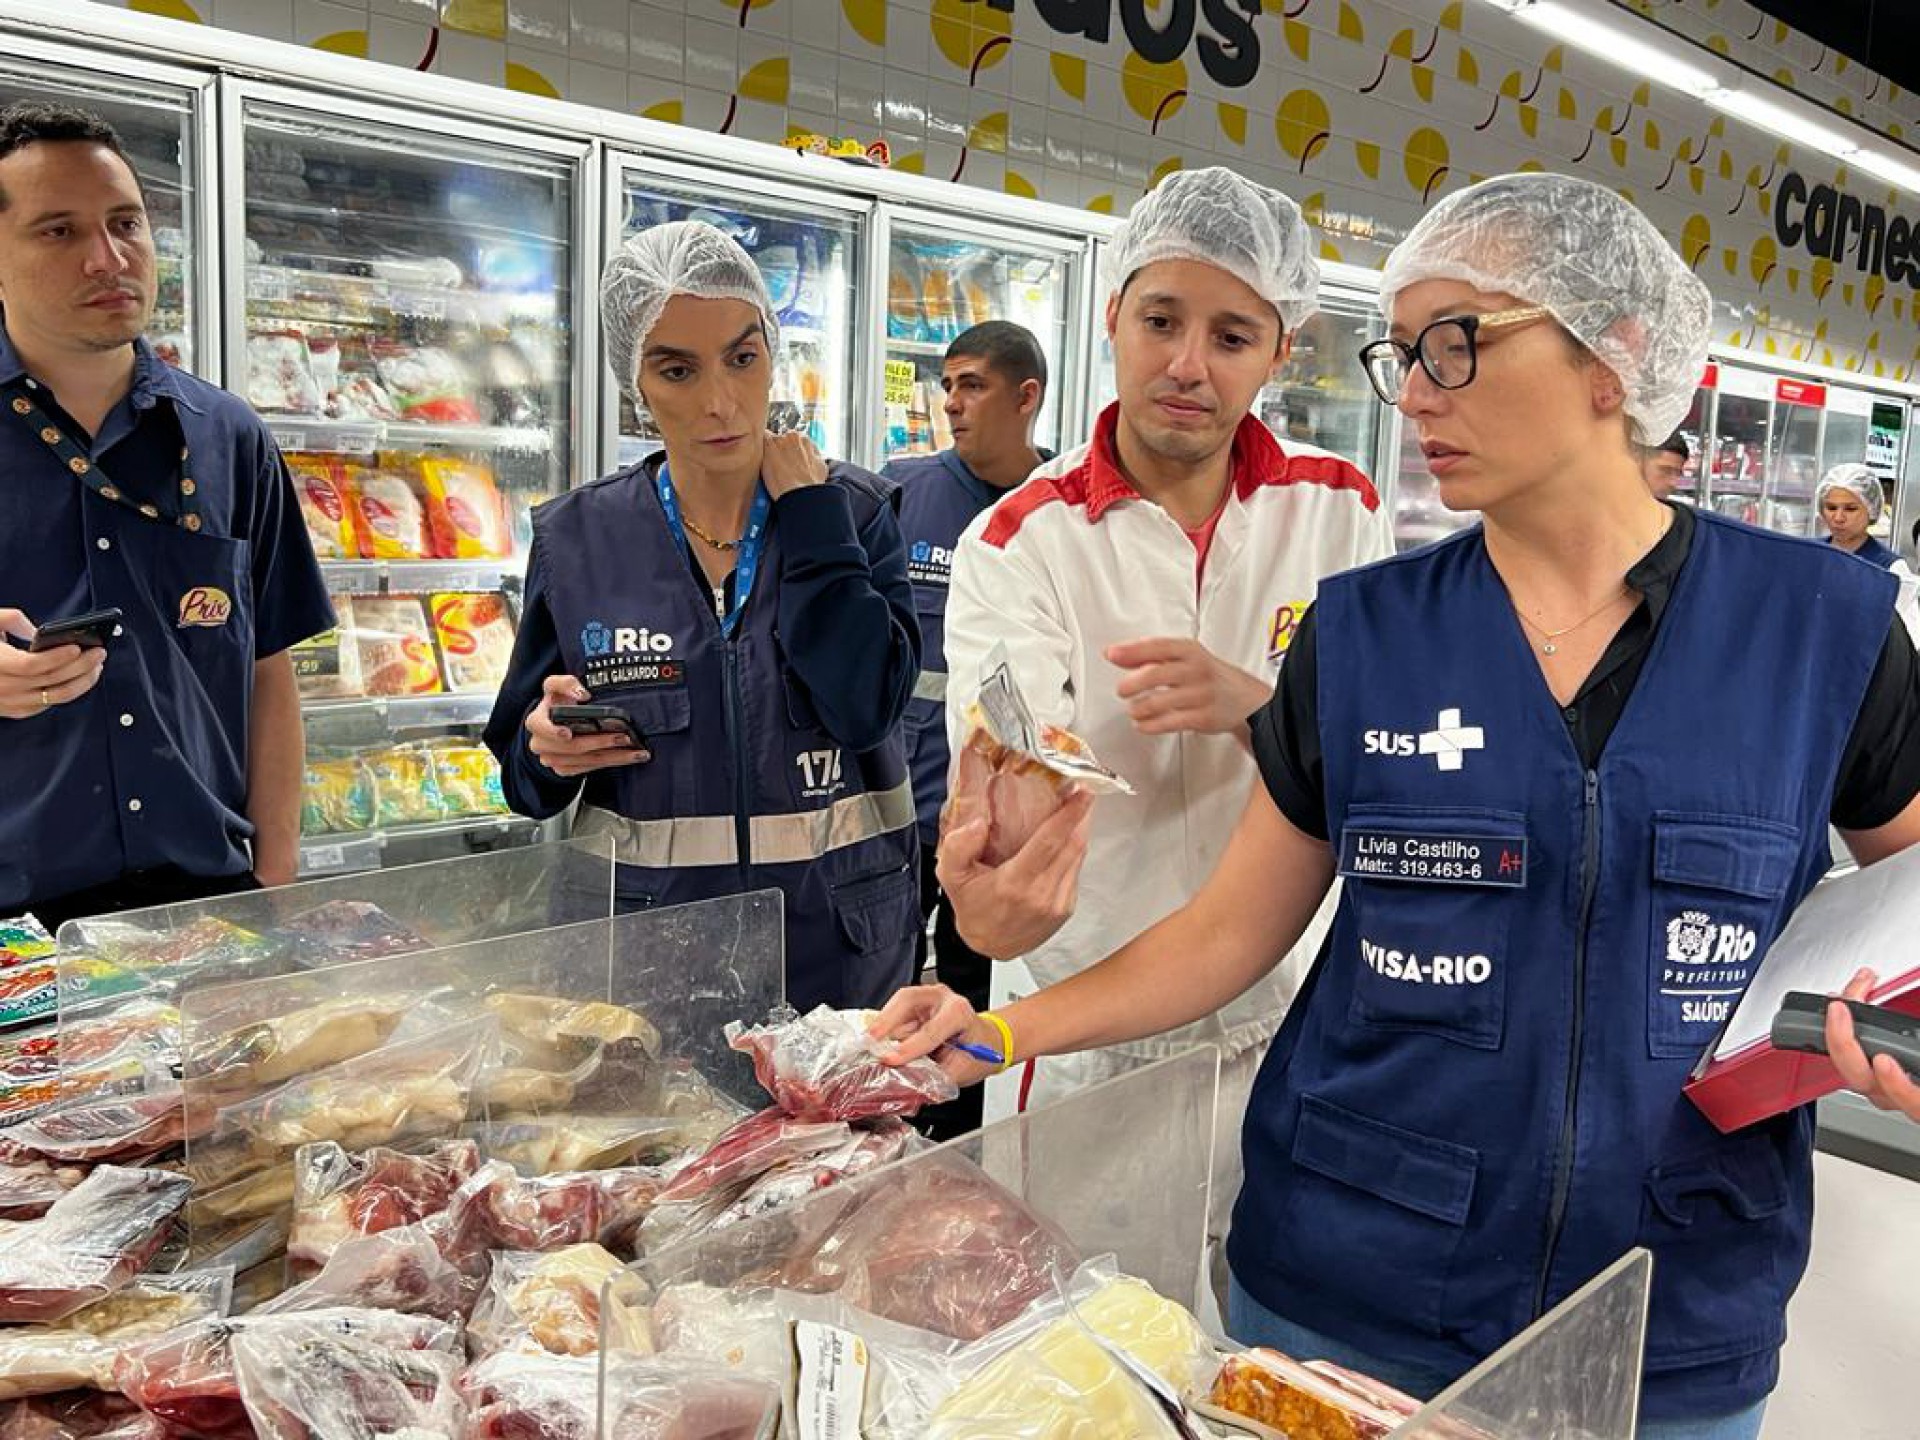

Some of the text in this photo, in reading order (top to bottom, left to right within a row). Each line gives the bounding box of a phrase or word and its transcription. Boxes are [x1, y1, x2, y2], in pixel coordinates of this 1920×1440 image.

[614, 627, 673, 652] Rio
[1363, 730, 1416, 757] SUS
[1358, 836, 1480, 860] Lívia Castilho
[1399, 860, 1483, 879] 319.463-6
[1499, 848, 1522, 874] A+
[1711, 923, 1756, 963] Rio
